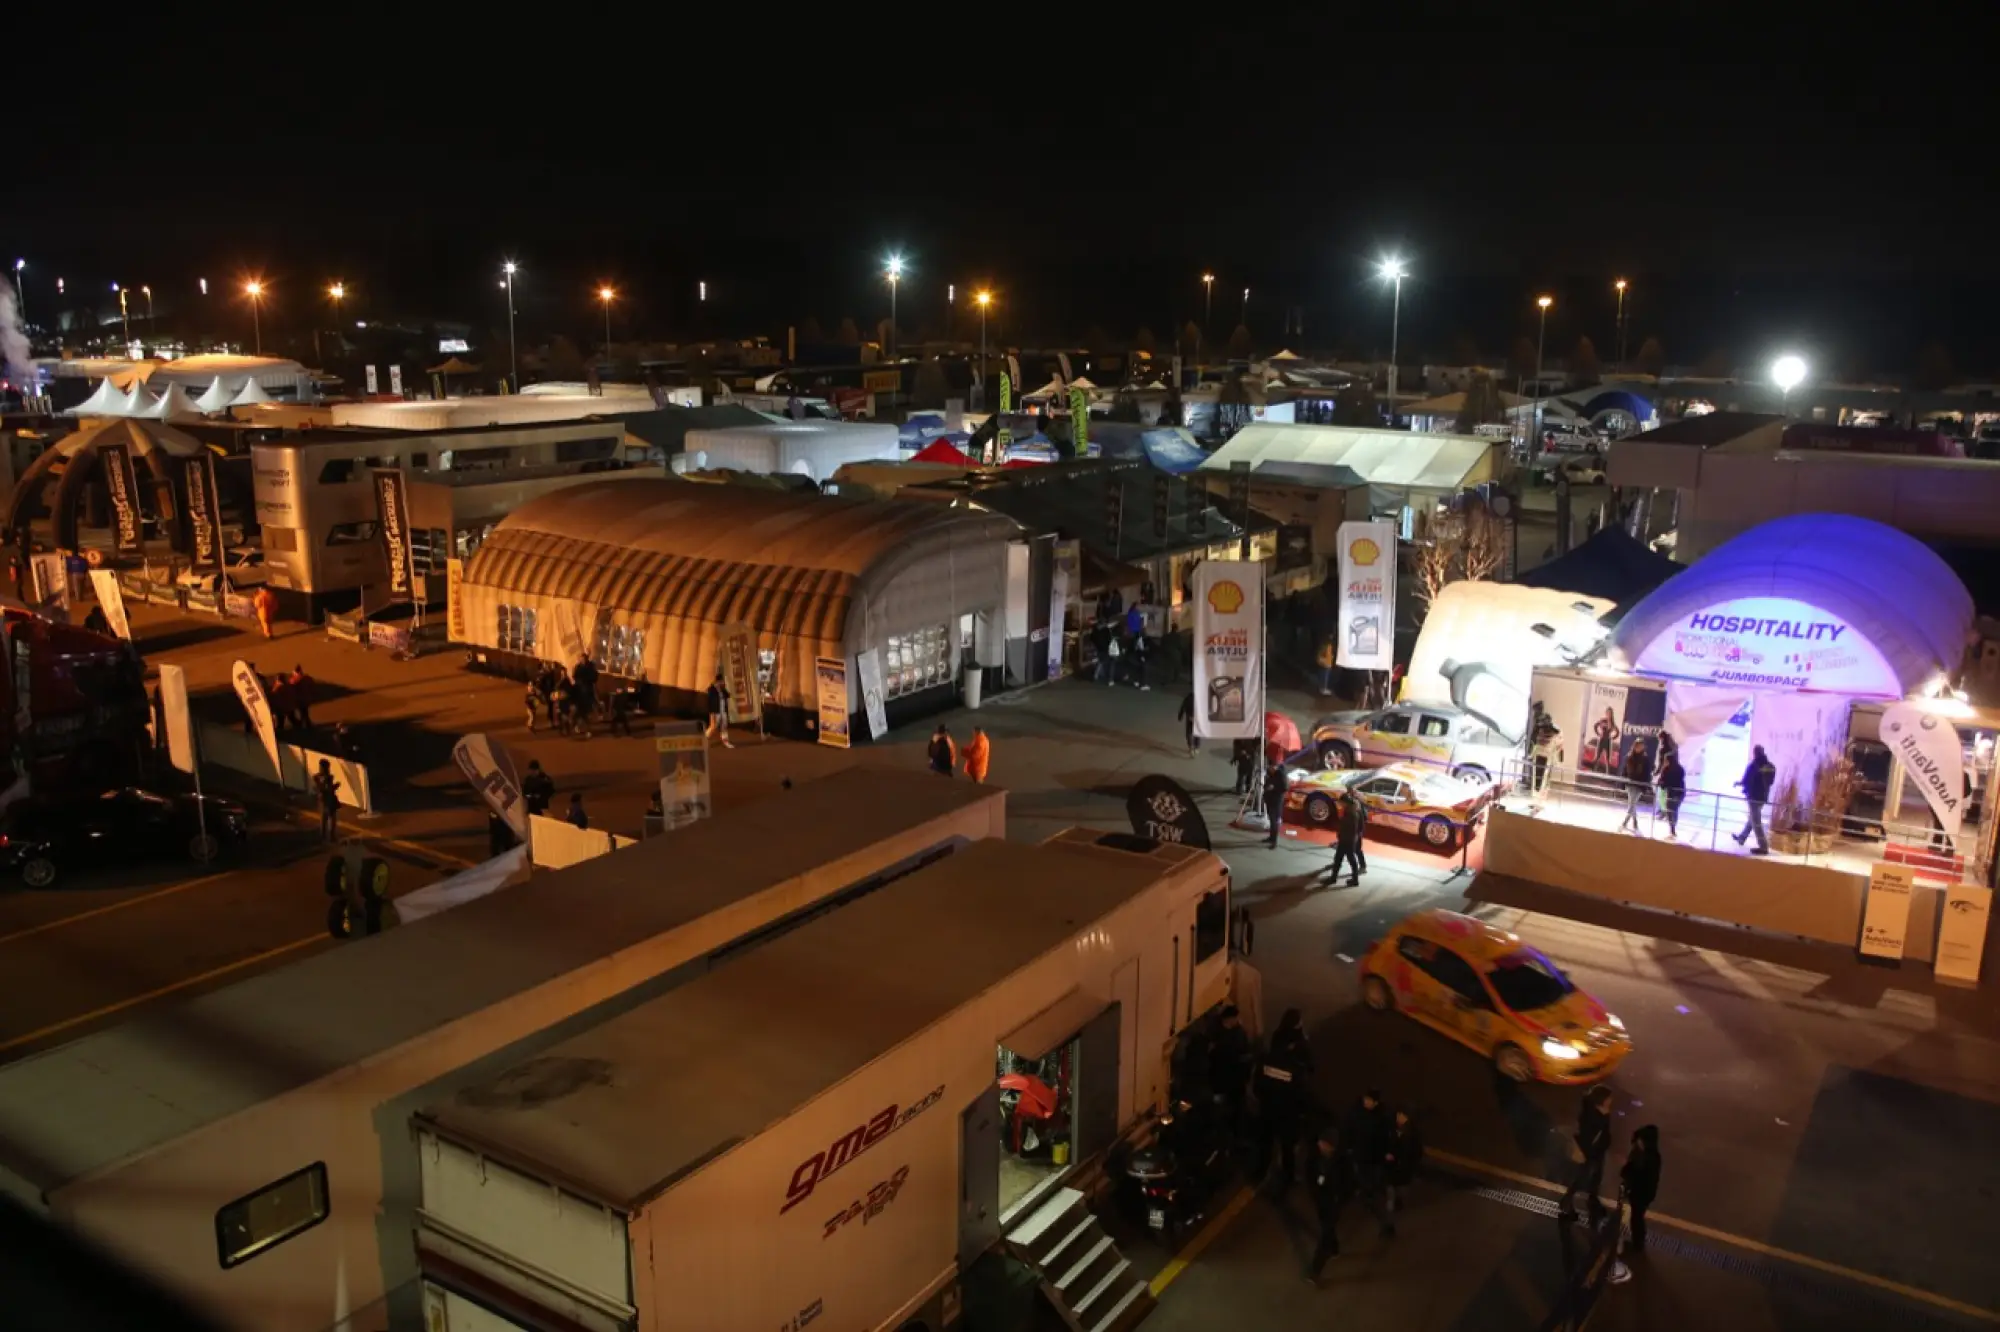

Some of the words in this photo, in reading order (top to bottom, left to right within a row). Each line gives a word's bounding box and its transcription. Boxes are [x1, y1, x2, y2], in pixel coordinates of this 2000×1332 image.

[1689, 612, 1846, 642] HOSPITALITY
[1711, 670, 1809, 687] #JUMBOSPACE
[780, 1104, 898, 1215] gma
